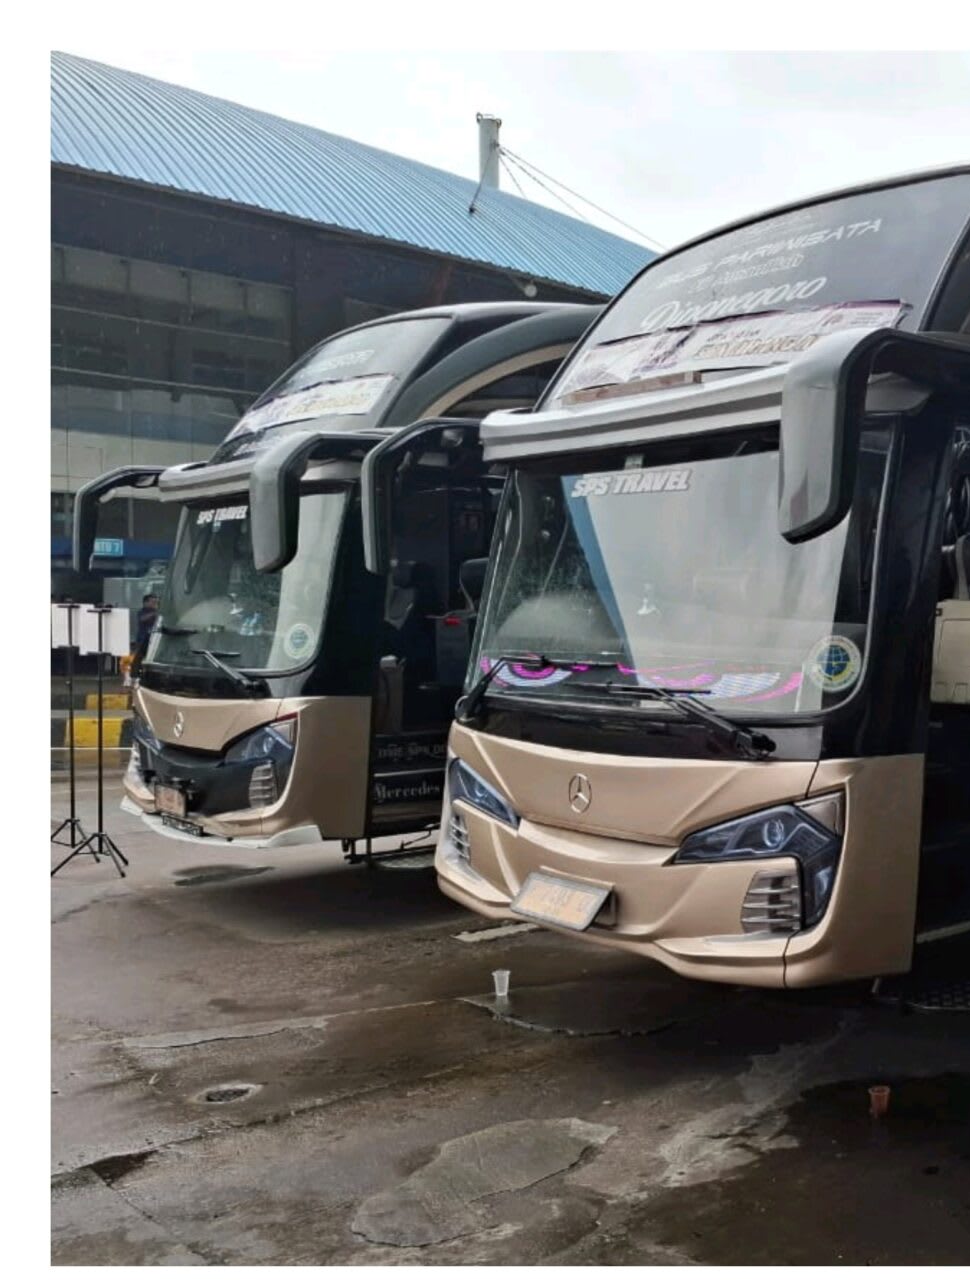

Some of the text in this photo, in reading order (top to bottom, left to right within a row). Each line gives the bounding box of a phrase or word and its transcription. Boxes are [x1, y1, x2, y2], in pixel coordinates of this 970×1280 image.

[570, 466, 692, 498] SPS TRAVEL
[214, 505, 249, 521] TRAVEL
